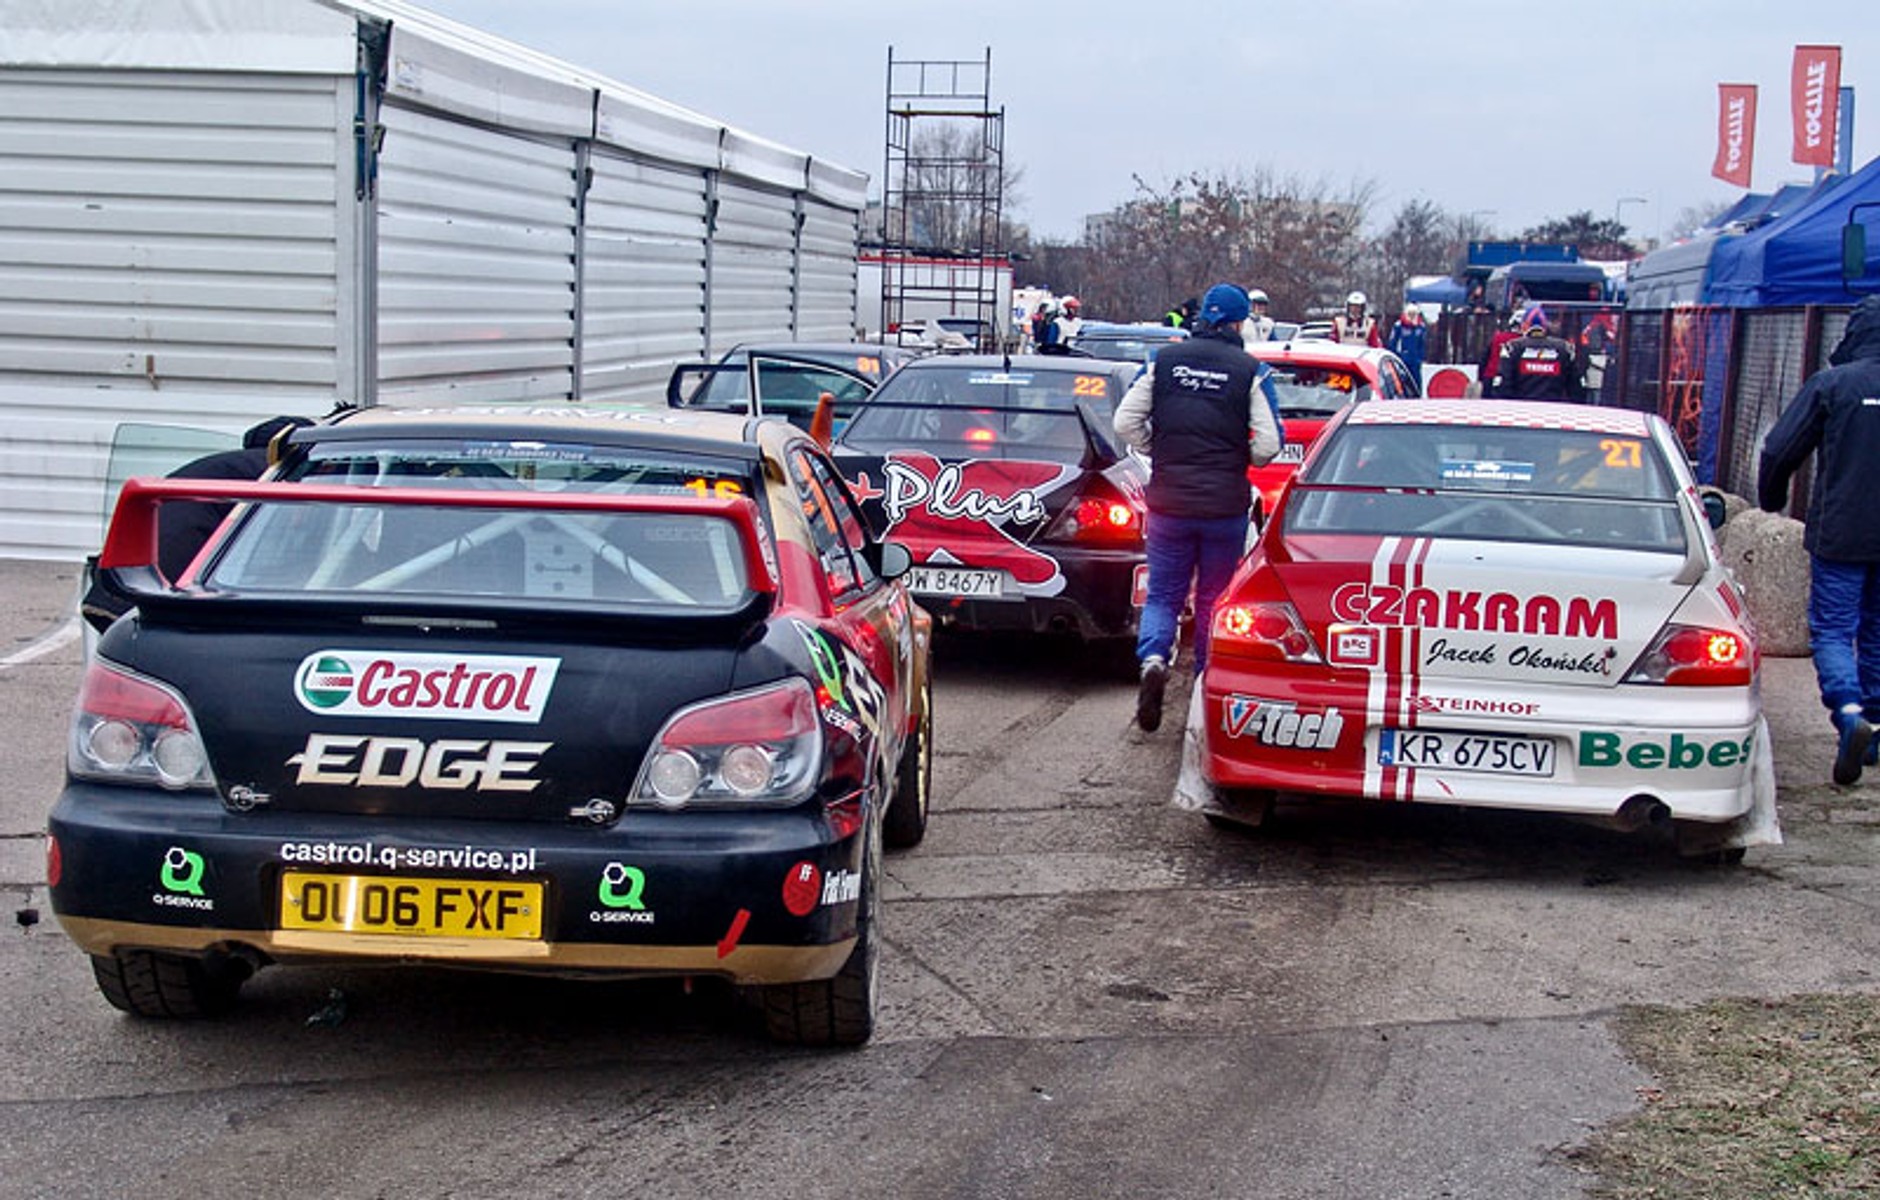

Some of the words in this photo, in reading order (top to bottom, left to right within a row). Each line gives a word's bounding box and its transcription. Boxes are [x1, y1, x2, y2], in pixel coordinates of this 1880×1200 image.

[1074, 375, 1106, 396] 22
[1327, 373, 1352, 390] 24
[1599, 439, 1643, 468] 27
[882, 462, 1045, 525] Plus
[1332, 582, 1619, 640] CZAKRAM
[1426, 638, 1496, 666] Jacek
[357, 659, 538, 712] Castrol
[1415, 695, 1541, 715] STEINHOF
[285, 732, 554, 792] EDGE
[1398, 734, 1443, 765] KR
[1454, 738, 1551, 772] 675CV
[281, 842, 536, 874] castrol.q-service.pl
[152, 893, 214, 910] Q-SERVICE
[434, 886, 525, 931] FXF
[589, 910, 655, 924] Q-SERVICE
